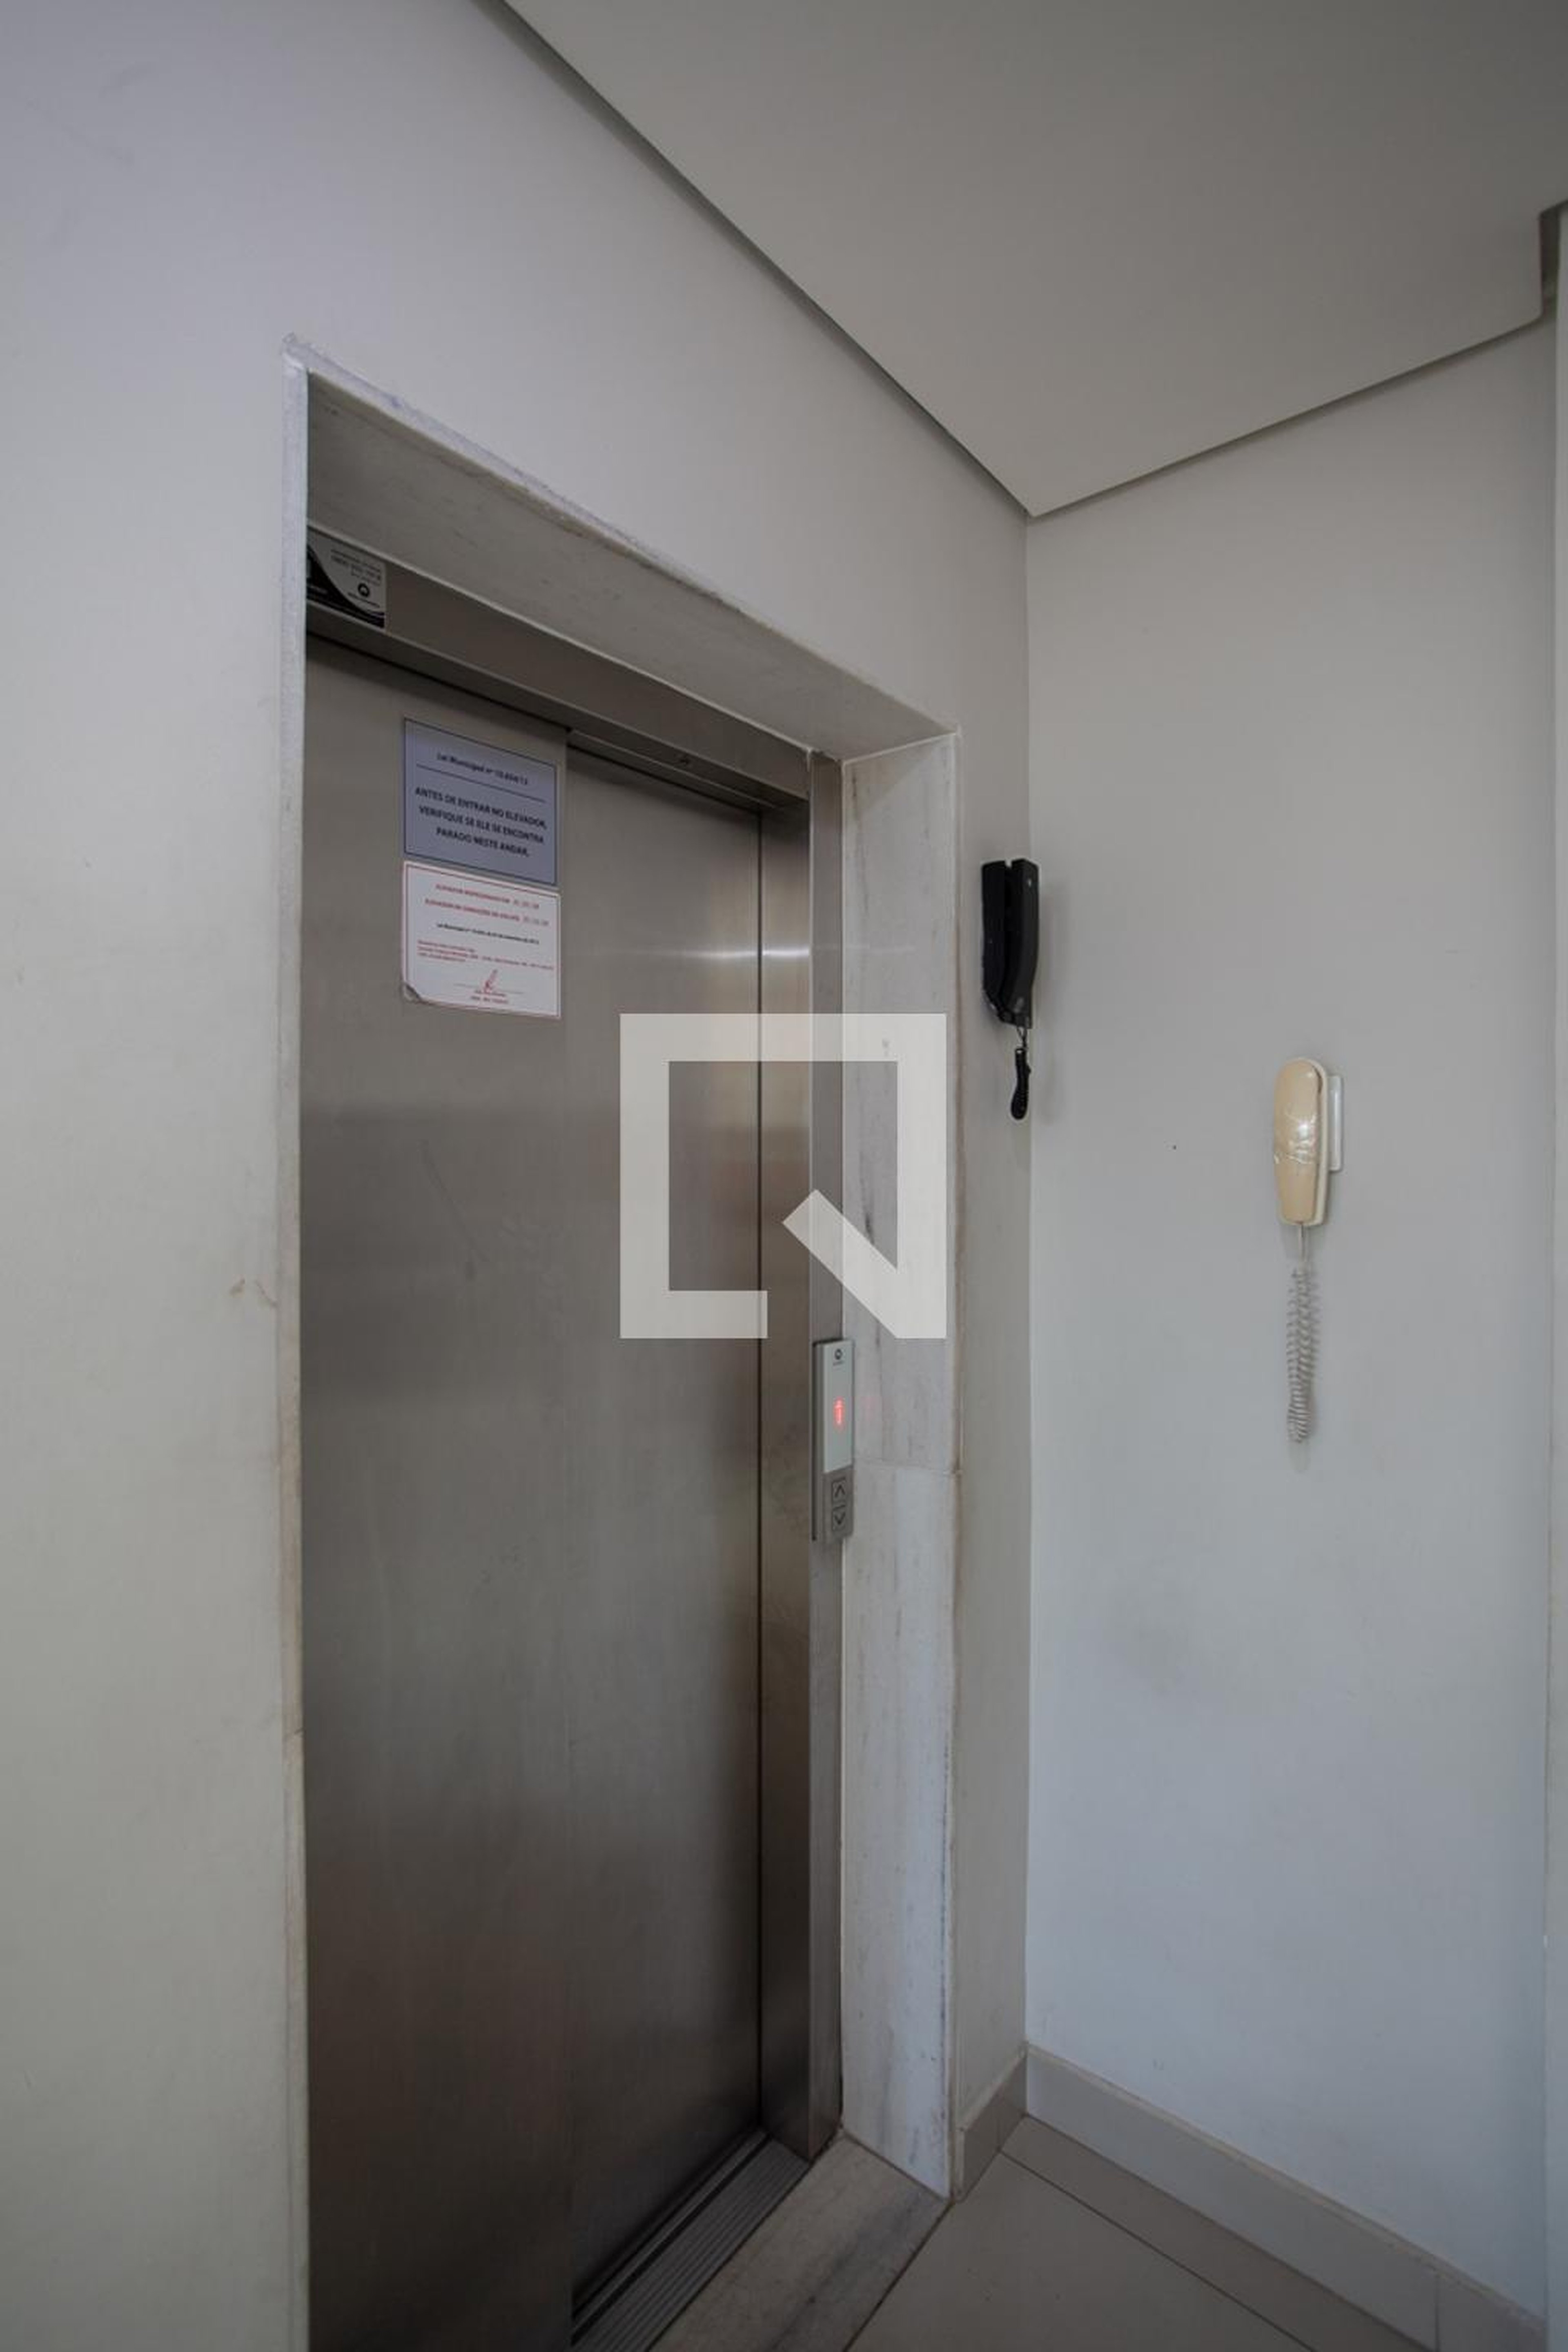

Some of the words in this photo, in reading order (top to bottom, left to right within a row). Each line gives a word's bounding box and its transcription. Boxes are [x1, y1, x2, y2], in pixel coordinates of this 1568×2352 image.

[450, 755, 485, 774] Municipal
[415, 787, 443, 802] ANTES
[445, 794, 455, 805] DE
[458, 797, 490, 813] ENTRAR
[492, 808, 504, 817] NO
[419, 806, 463, 824] VERIFIQUE
[466, 817, 474, 827] SE
[477, 821, 490, 831] ELE
[492, 824, 501, 833] SE
[503, 828, 544, 844] ENCONTRA
[436, 828, 472, 844] PARADO
[473, 836, 498, 849] NESTE
